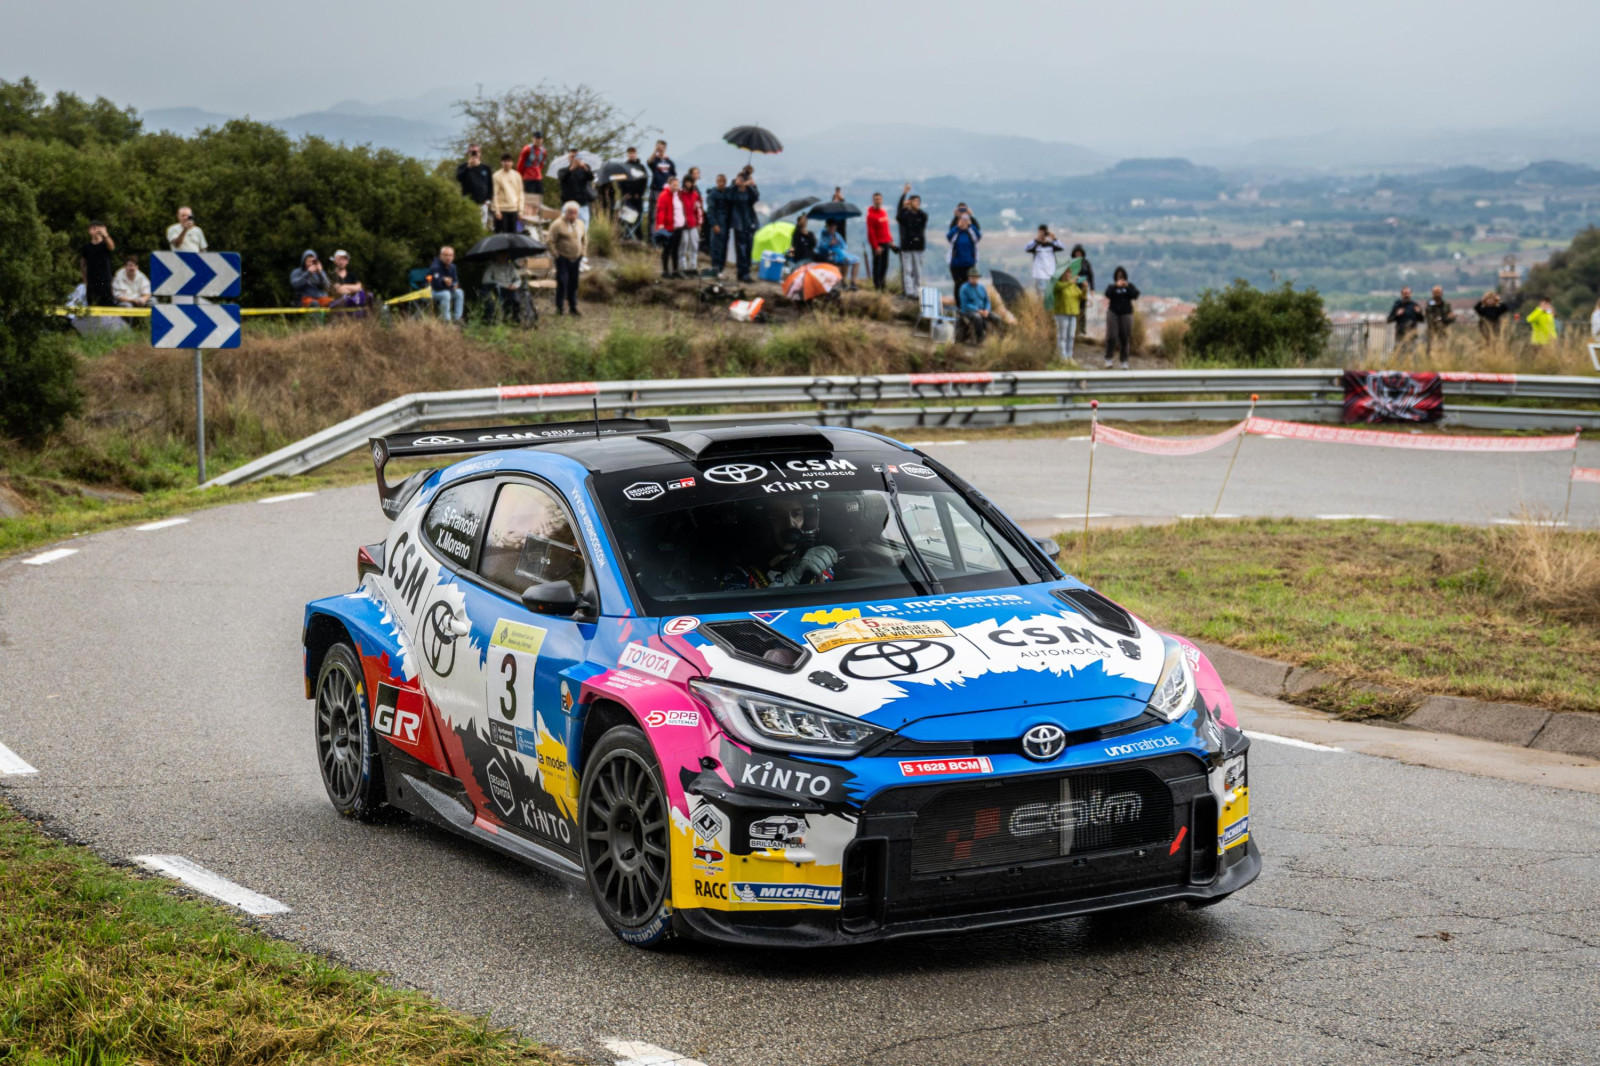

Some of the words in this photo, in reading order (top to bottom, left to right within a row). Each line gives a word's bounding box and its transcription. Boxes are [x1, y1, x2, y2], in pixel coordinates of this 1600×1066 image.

[786, 459, 858, 471] CSM
[627, 485, 658, 494] SEGURO
[669, 480, 696, 490] GR
[631, 489, 660, 497] TOYOTA
[435, 528, 471, 560] X.Moreno
[388, 531, 430, 616] CSM
[866, 604, 899, 613] la
[903, 594, 1024, 609] moderna
[881, 607, 939, 617] PINTURA
[672, 619, 693, 630] E
[861, 618, 879, 628] 5
[890, 624, 931, 632] MASIES
[988, 626, 1114, 649] CSM
[626, 647, 670, 673] TOYOTA
[500, 653, 517, 720] 3
[669, 711, 698, 720] DPB
[374, 704, 420, 741] GR
[903, 764, 914, 773] S
[916, 763, 947, 772] 1628
[948, 761, 980, 771] BCM
[490, 774, 510, 789] SEGURO
[493, 785, 512, 800] TOYOTA
[750, 840, 788, 848] BRILLANT
[789, 841, 806, 849] CAR
[694, 879, 728, 900] RACC
[759, 887, 841, 899] MICHELIN
[622, 917, 664, 943] MICHELIN
